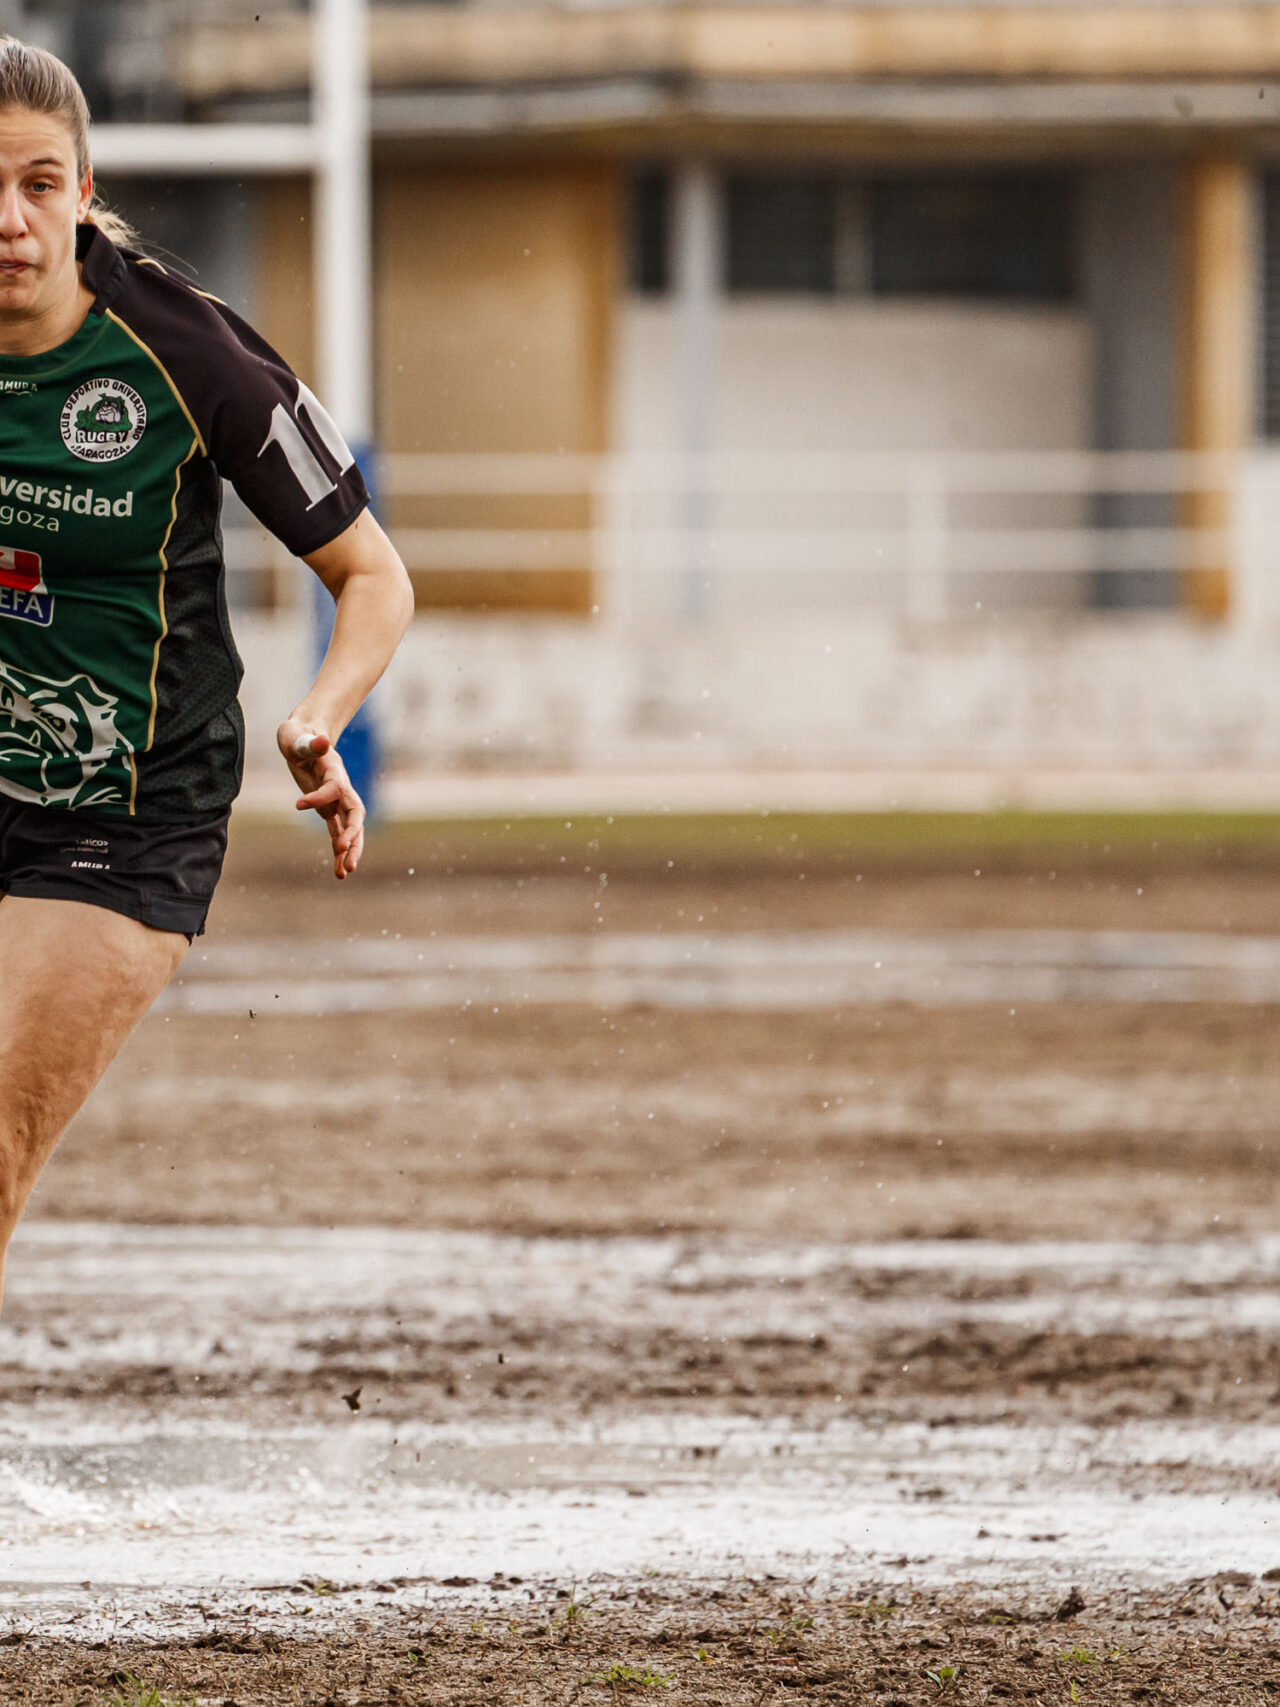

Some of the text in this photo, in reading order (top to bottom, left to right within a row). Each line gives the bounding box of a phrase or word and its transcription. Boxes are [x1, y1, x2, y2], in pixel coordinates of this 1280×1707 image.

[62, 380, 145, 440] CLUB DEPORTIVO UNIVERSITARIO
[76, 430, 128, 443] RUGBY
[73, 445, 127, 459] ZARAGOZA
